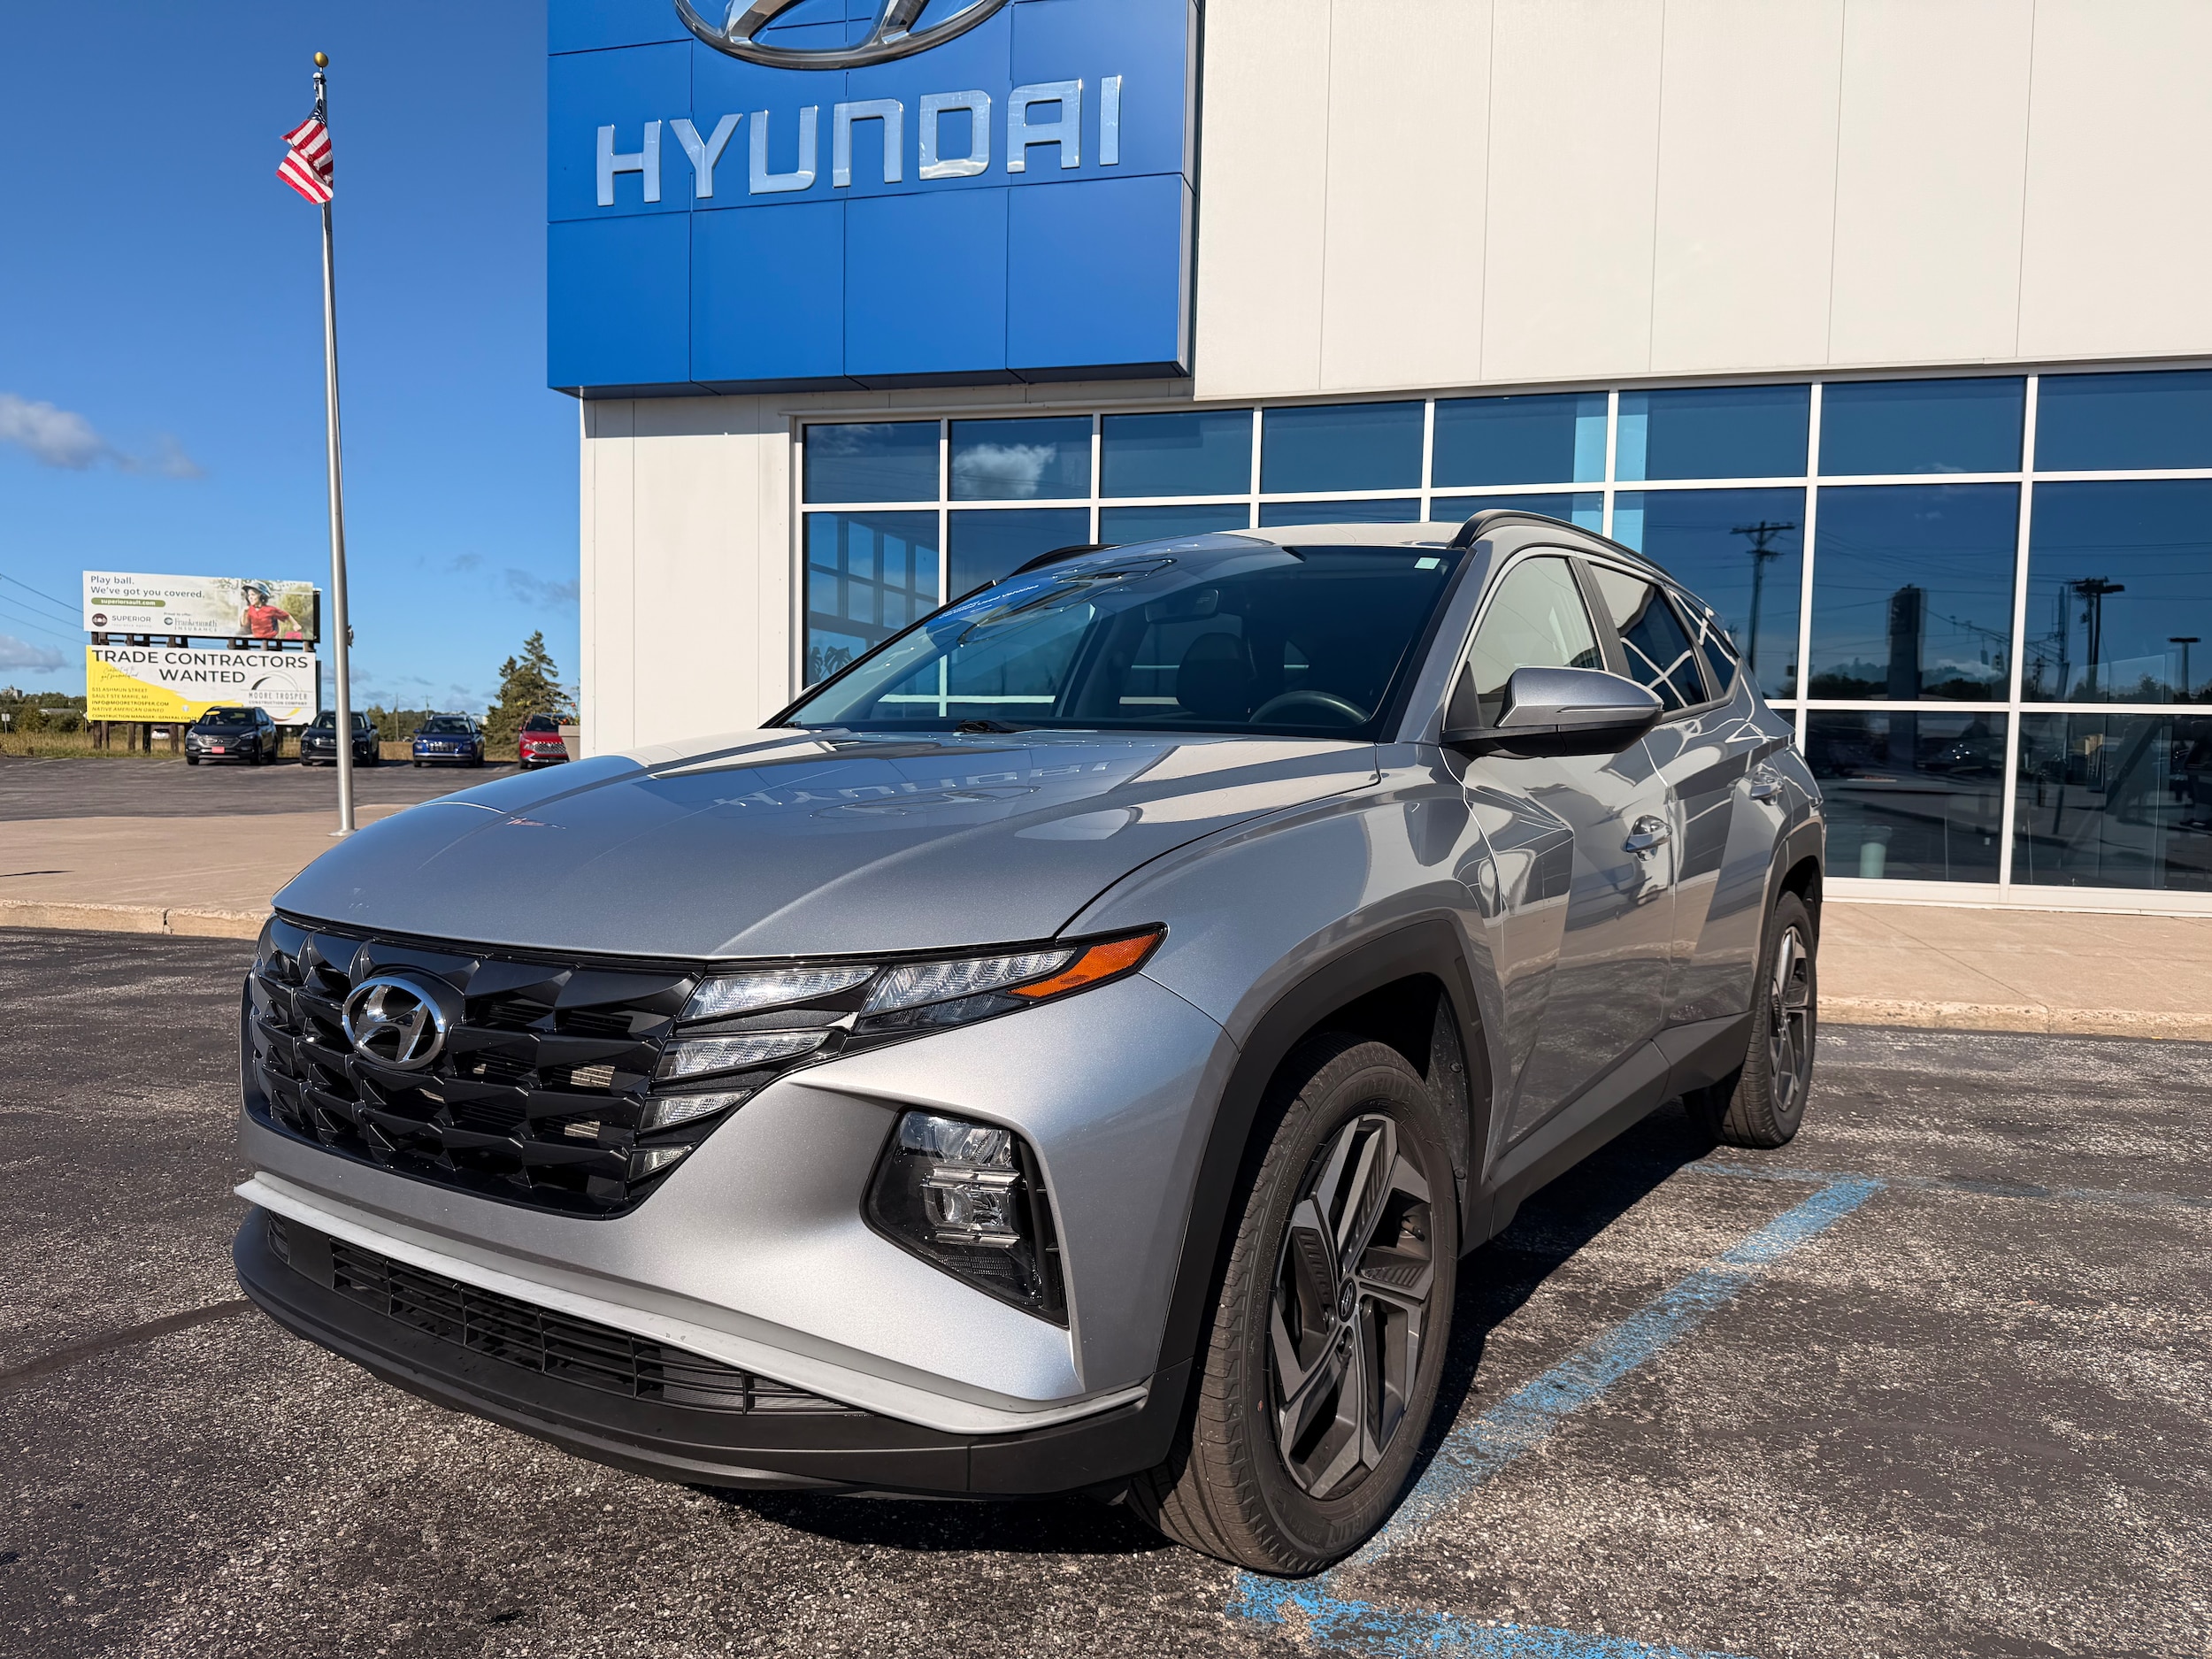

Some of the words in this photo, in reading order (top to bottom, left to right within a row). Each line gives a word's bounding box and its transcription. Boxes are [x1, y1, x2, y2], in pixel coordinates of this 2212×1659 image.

[596, 75, 1123, 207] HYUNDAI
[90, 576, 111, 586] Play
[91, 586, 120, 595] We've
[123, 588, 140, 596] got
[92, 649, 159, 664] TRADE
[165, 652, 308, 669] CONTRACTORS
[159, 669, 245, 683] WANTED
